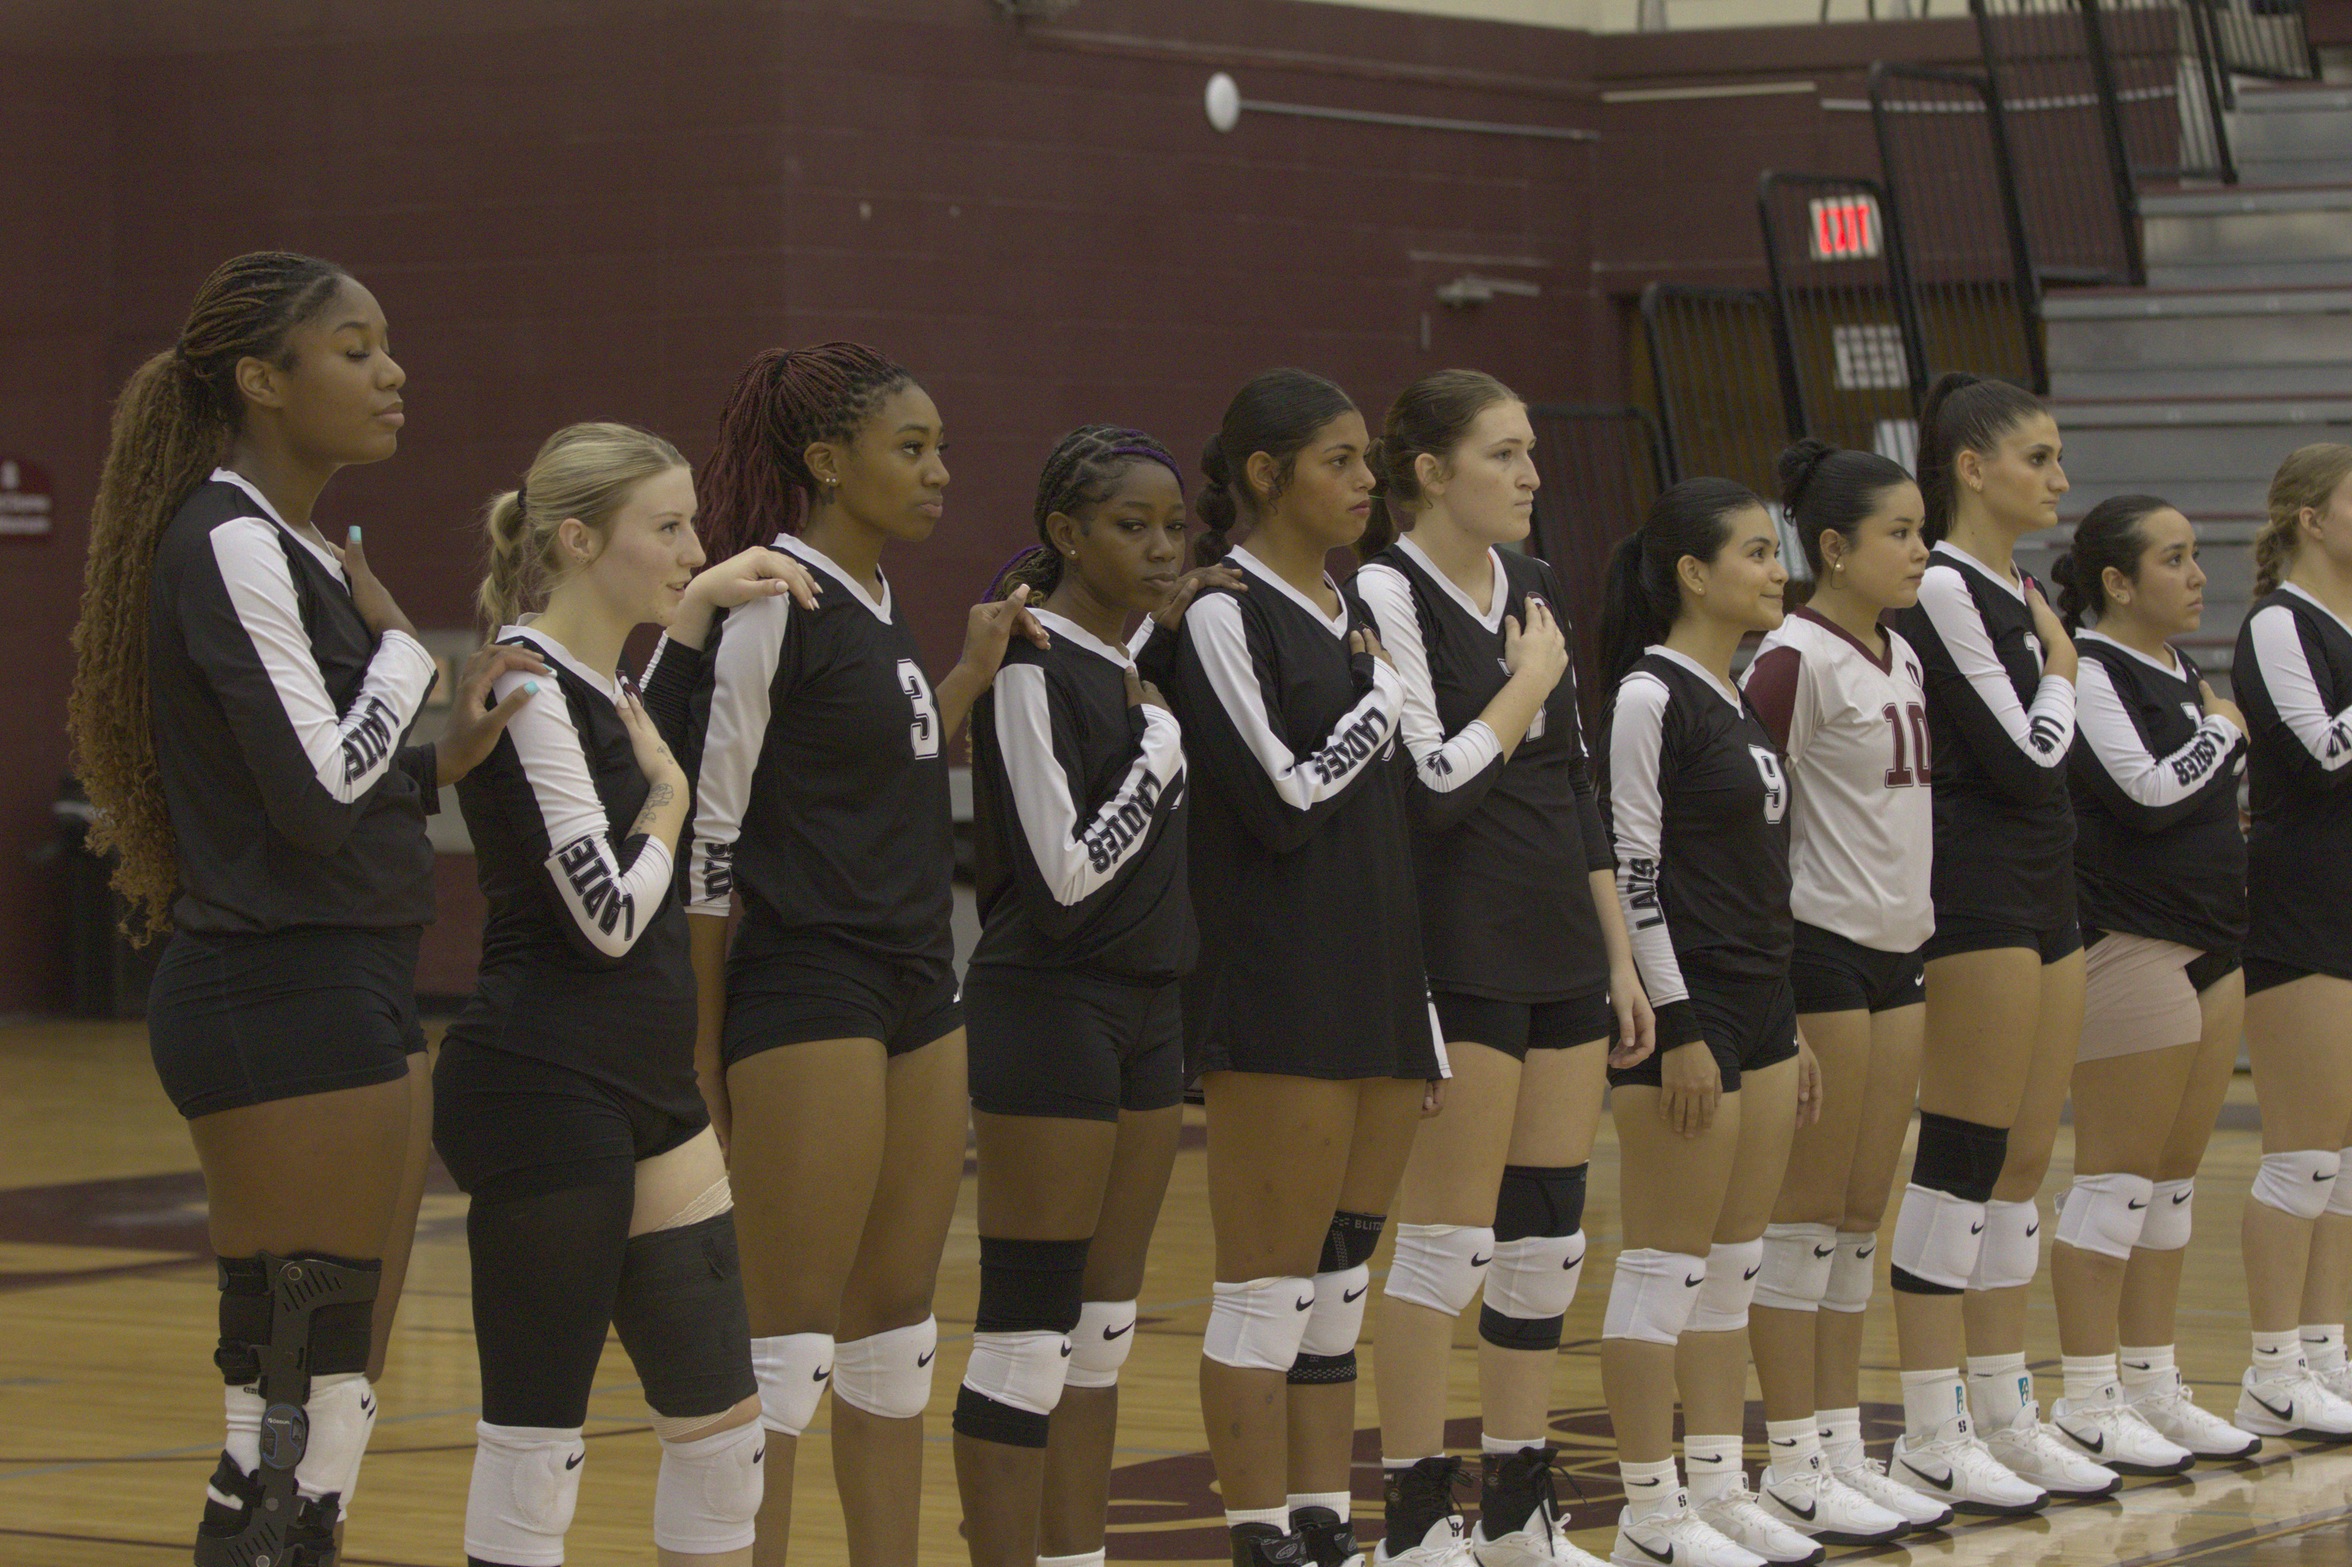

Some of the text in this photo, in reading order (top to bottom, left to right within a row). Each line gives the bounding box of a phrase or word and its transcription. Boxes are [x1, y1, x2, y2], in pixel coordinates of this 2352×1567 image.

[897, 658, 939, 760] 3
[1882, 702, 1932, 788] 10
[1086, 768, 1162, 874] LADIES
[1748, 744, 1788, 824] 9
[555, 835, 635, 941] LADIE
